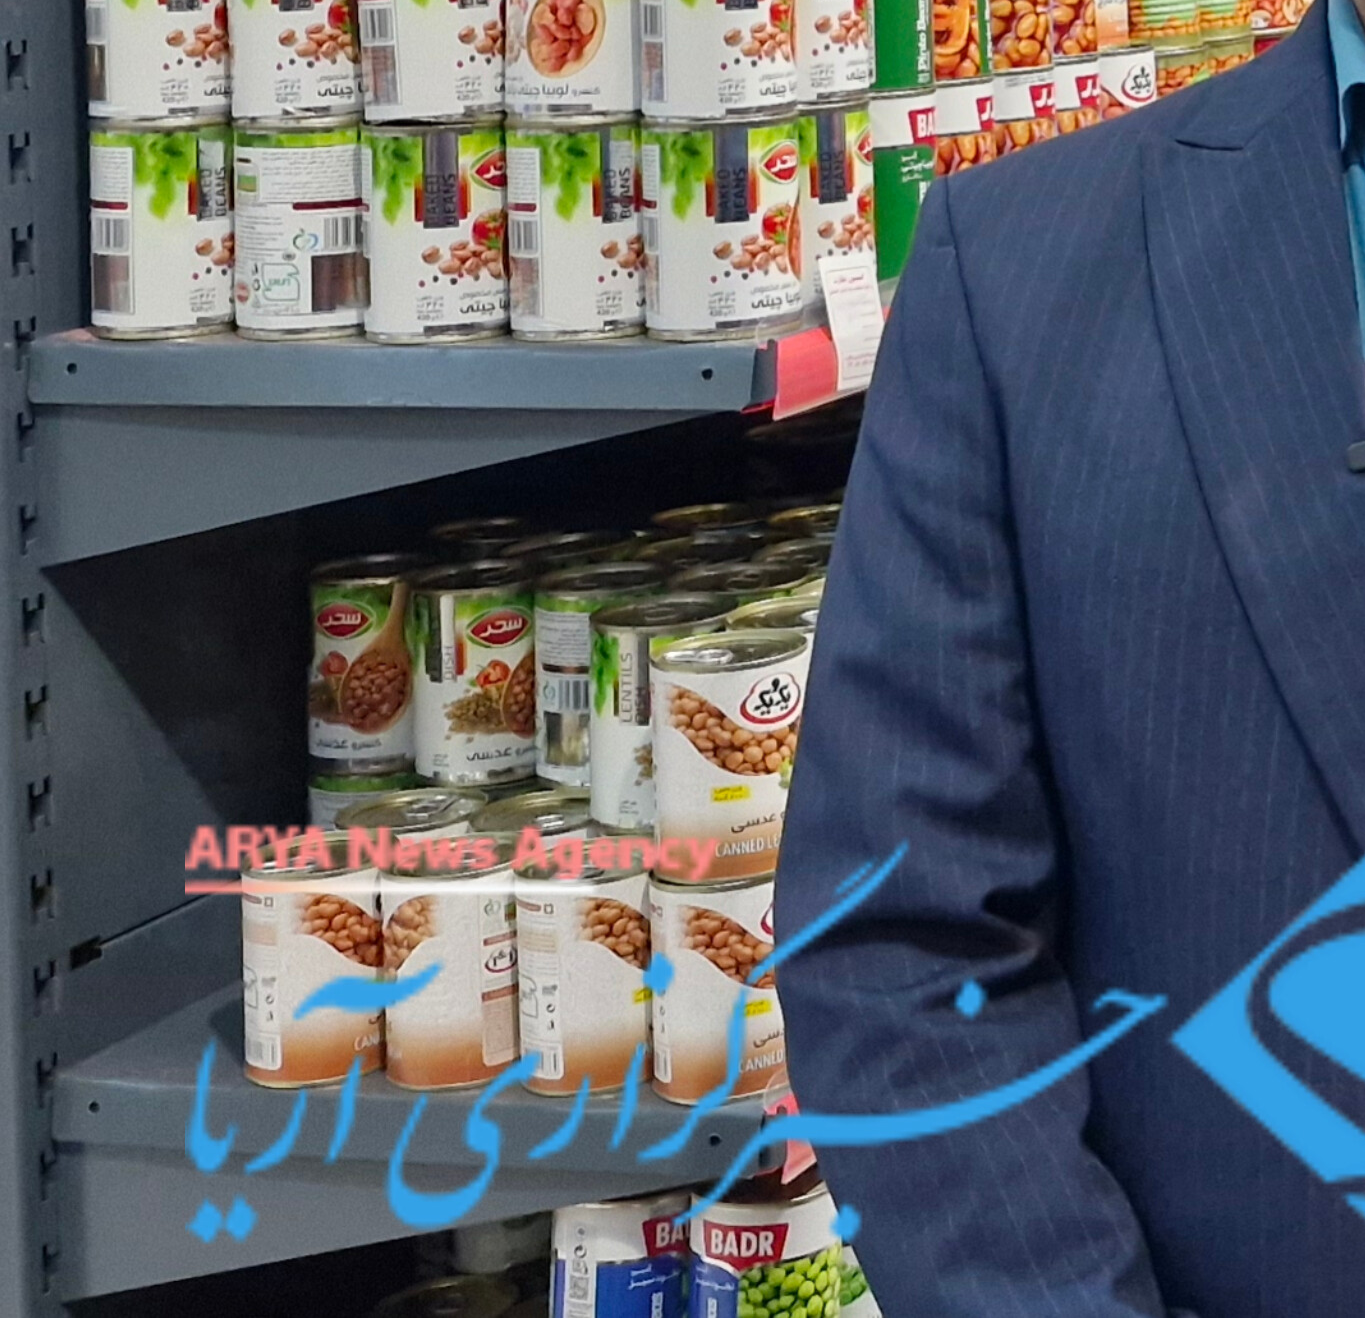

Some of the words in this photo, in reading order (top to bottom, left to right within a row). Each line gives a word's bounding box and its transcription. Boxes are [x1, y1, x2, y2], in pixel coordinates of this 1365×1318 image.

[917, 33, 928, 71] Pinto
[322, 612, 362, 627] سحر
[479, 617, 523, 638] سحر
[621, 652, 633, 724] LENTILS
[466, 747, 511, 763] عدسی
[730, 812, 776, 834] عدسی
[714, 837, 765, 859] CANNED
[711, 1228, 775, 1258] BADR
